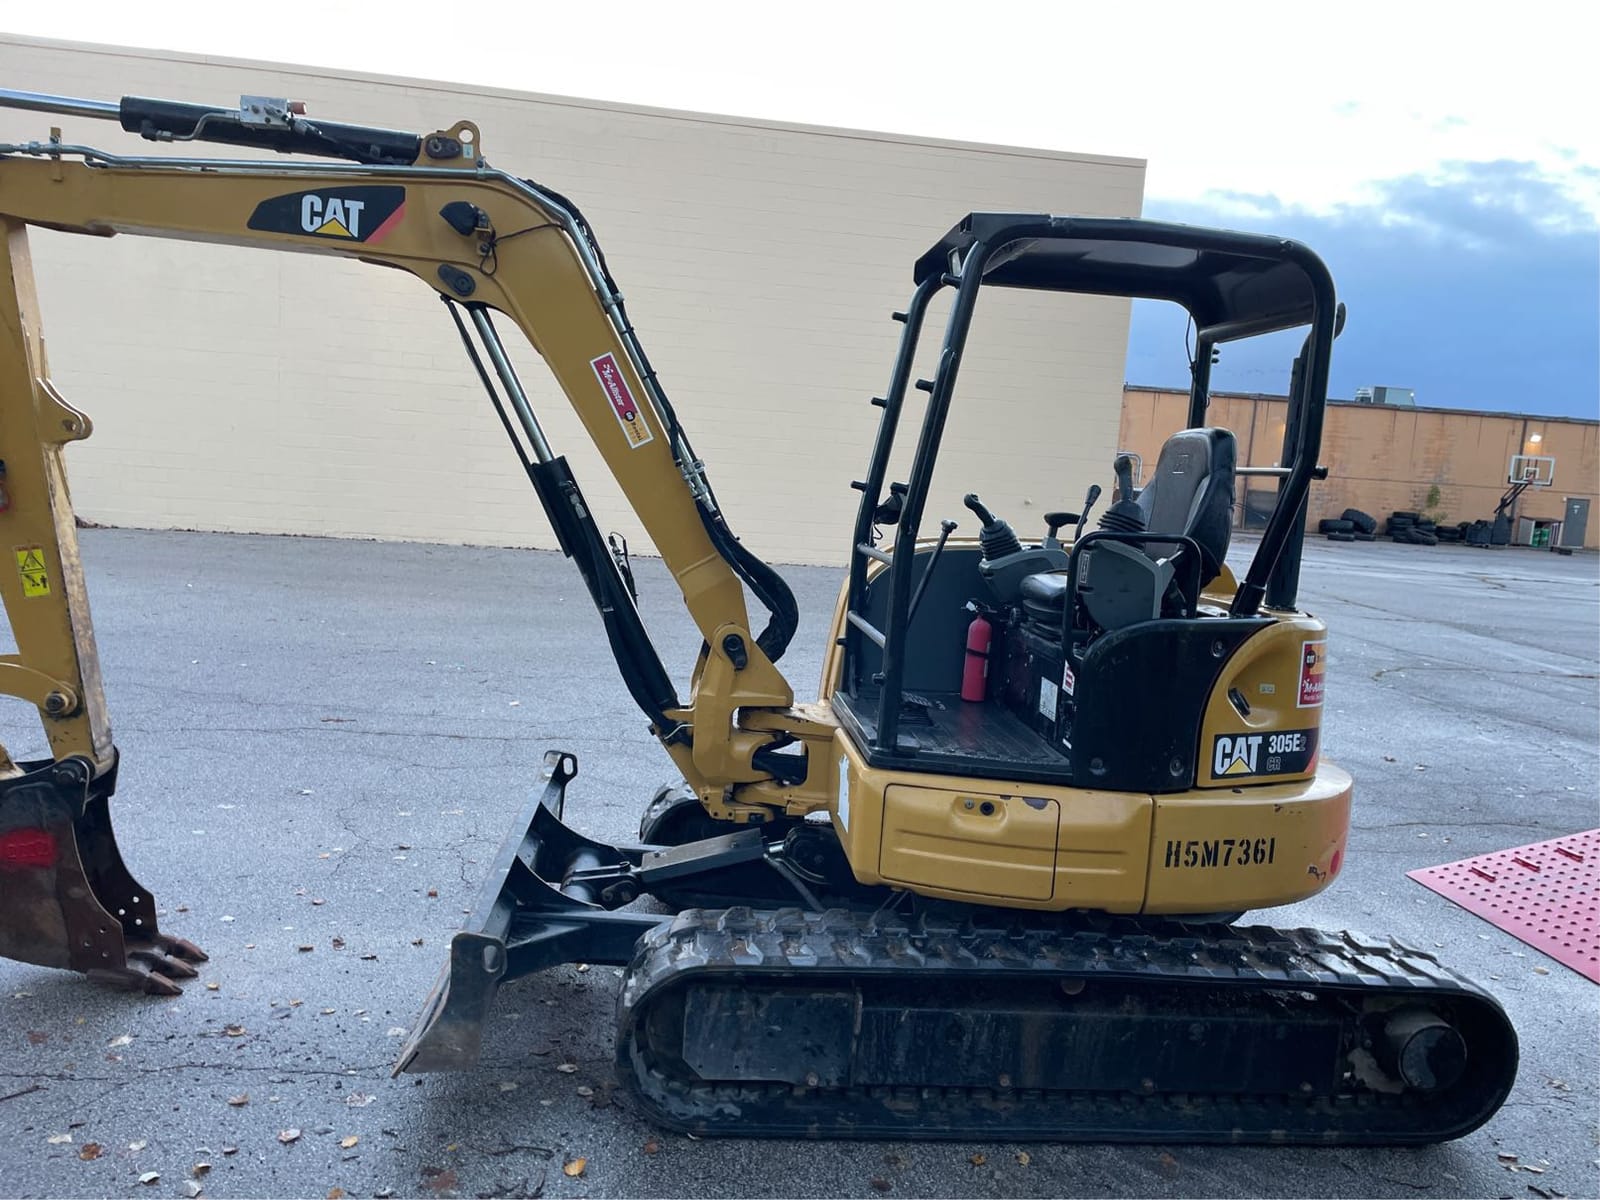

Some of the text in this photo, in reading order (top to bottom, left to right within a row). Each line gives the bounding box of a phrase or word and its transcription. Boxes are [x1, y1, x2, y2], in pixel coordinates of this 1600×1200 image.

[301, 194, 364, 238] CAT
[1214, 734, 1307, 775] CAT 305E2
[1266, 756, 1281, 772] CR
